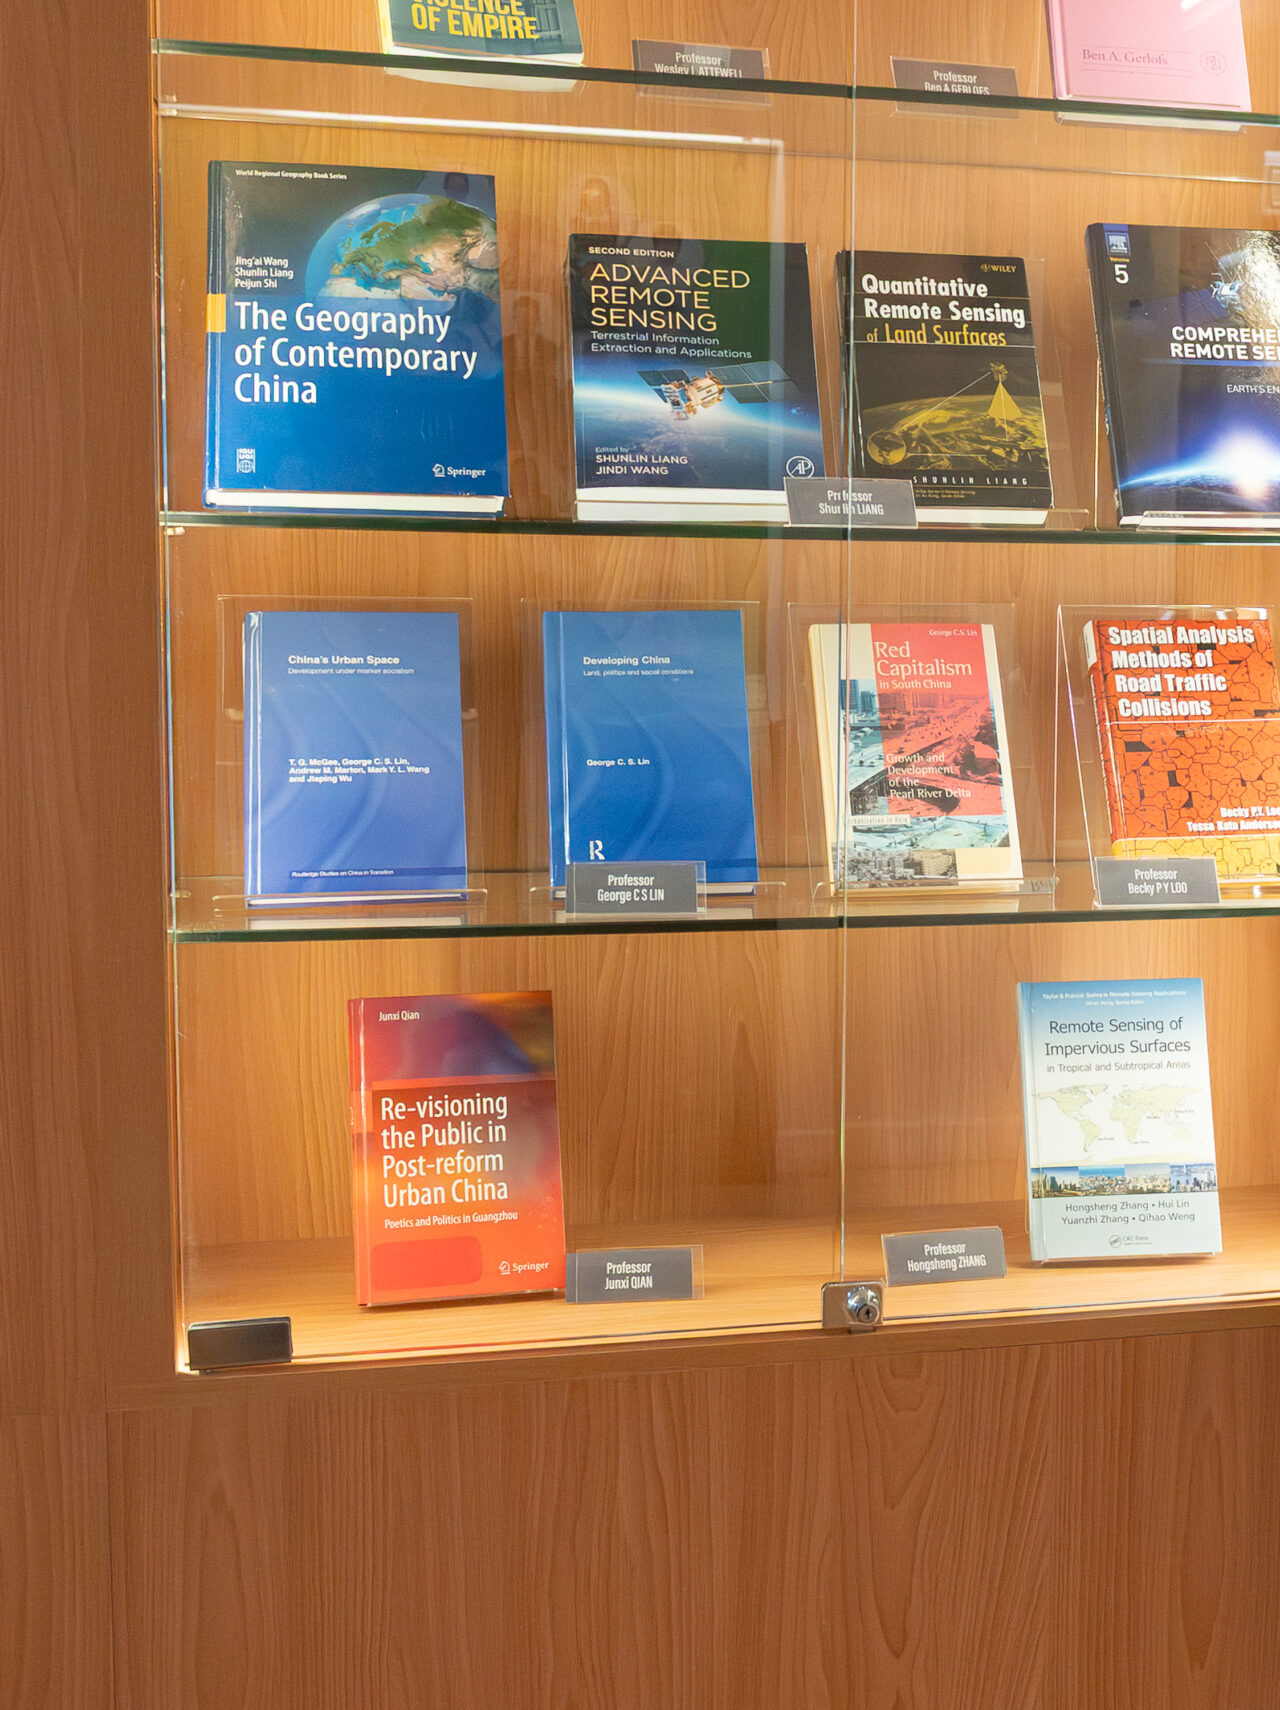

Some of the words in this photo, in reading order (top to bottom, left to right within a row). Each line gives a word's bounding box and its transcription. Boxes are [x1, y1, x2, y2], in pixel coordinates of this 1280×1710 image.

[411, 4, 440, 31] OF
[447, 9, 540, 39] EMPIRE
[676, 52, 722, 64] Professor
[654, 63, 689, 75] Wesley
[933, 70, 977, 83] Professor
[588, 246, 630, 256] SECOND
[633, 248, 675, 258] EDITION
[234, 256, 262, 268] Jing'ai
[262, 257, 288, 269] Wang
[990, 264, 1017, 273] WILEY
[234, 267, 268, 277] Shunlin
[269, 268, 294, 280] Liang
[590, 263, 750, 288] ADVANCED
[1114, 264, 1129, 284] 5
[234, 278, 262, 290] Peijun
[264, 278, 278, 288] Shi
[861, 273, 988, 298] Quantitative
[590, 285, 711, 310] REMOTE
[590, 308, 717, 332] SENSING
[864, 298, 942, 320] Remote
[949, 300, 1026, 329] Sensing
[234, 302, 288, 330] The
[296, 302, 451, 343] Geography
[590, 330, 649, 342] Terrestrial
[652, 332, 720, 346] Information
[866, 328, 878, 343] of
[885, 322, 927, 344] Land
[933, 324, 1007, 346] Surfaces
[591, 342, 652, 354] Extraction
[655, 346, 677, 355] and
[680, 346, 752, 359] Applications
[1170, 343, 1249, 360] REMOTE
[234, 336, 266, 366] of
[272, 337, 478, 380] Contemporary
[234, 373, 317, 404] China
[1227, 384, 1266, 394] EARTH'S
[596, 454, 648, 463] SHUNLIN
[652, 456, 688, 464] LIANG
[447, 466, 486, 478] Springer
[596, 466, 627, 474] JINDI
[630, 466, 669, 475] WANG
[913, 476, 974, 484] SHUNLIN
[986, 477, 1028, 485] LIANG
[856, 503, 884, 515] LIANG
[1108, 626, 1174, 646] Spatial
[1177, 626, 1255, 645] Analysis
[874, 641, 911, 658] Red
[288, 655, 329, 664] China's
[331, 656, 364, 664] Urban
[366, 655, 399, 666] Space
[583, 656, 639, 666] Developing
[641, 656, 670, 664] China
[1112, 650, 1192, 669] Methods
[1194, 650, 1214, 667] of
[877, 659, 972, 680] Capitalism
[880, 680, 889, 689] in
[891, 680, 920, 689] South
[923, 679, 952, 689] China
[1114, 674, 1162, 692] Road
[1164, 673, 1227, 692] Traffic
[1118, 697, 1212, 717] Collisions
[586, 759, 616, 767] George
[617, 758, 626, 766] C.
[886, 753, 924, 763] Growth
[926, 752, 945, 762] and
[368, 766, 388, 774] Mark
[406, 766, 430, 774] Wang
[887, 765, 954, 776] Development
[888, 776, 900, 787] of
[903, 777, 919, 786] the
[890, 788, 914, 799] Pearl
[917, 789, 942, 798] River
[945, 788, 972, 798] Delta
[1186, 821, 1215, 832] Tessa
[1217, 820, 1239, 831] Kate
[590, 840, 605, 860] R
[608, 874, 655, 886] Professor
[1134, 868, 1178, 880] Professor
[597, 888, 631, 904] George
[634, 889, 640, 901] C
[641, 889, 648, 901] S
[650, 889, 664, 901] LIN
[1128, 882, 1154, 896] Becky
[1156, 882, 1161, 893] P
[1163, 882, 1169, 893] Y
[1171, 882, 1188, 894] LOO
[378, 1011, 400, 1022] Junxi
[401, 1010, 420, 1020] Qian
[1050, 1020, 1104, 1034] Remote
[1110, 1018, 1164, 1034] Sensing
[1170, 1017, 1184, 1030] of
[1045, 1041, 1125, 1058] Impervious
[1130, 1039, 1191, 1053] Surfaces
[1058, 1063, 1091, 1074] Tropical
[1095, 1063, 1111, 1072] and
[1114, 1061, 1162, 1072] Subtropical
[1166, 1061, 1191, 1069] Areas
[381, 1092, 508, 1120] Re-visioning
[381, 1125, 416, 1149] the
[421, 1122, 483, 1147] Public
[488, 1120, 506, 1143] in
[383, 1150, 504, 1178] Post-reform
[384, 1182, 445, 1208] Urban
[451, 1178, 508, 1203] China
[1065, 1203, 1118, 1214] Hongsheng
[1120, 1202, 1149, 1210] Zhang
[1158, 1200, 1174, 1208] Hui
[1176, 1200, 1190, 1208] Lin
[384, 1218, 414, 1229] Poetics
[415, 1216, 431, 1227] and
[432, 1214, 461, 1226] Politics
[463, 1213, 471, 1223] in
[472, 1210, 518, 1223] Guangzhou
[1061, 1215, 1098, 1225] Yuanzhi
[1100, 1215, 1129, 1224] Zhang
[1138, 1213, 1166, 1223] Qihao
[1168, 1213, 1195, 1222] Weng
[924, 1243, 966, 1256] Professor
[512, 1262, 550, 1273] Springer
[606, 1261, 652, 1274] Professor
[907, 1258, 957, 1273] Hongsheng
[958, 1254, 986, 1268] ZHANG
[605, 1276, 630, 1290] Junxi
[631, 1275, 653, 1289] QIAN
